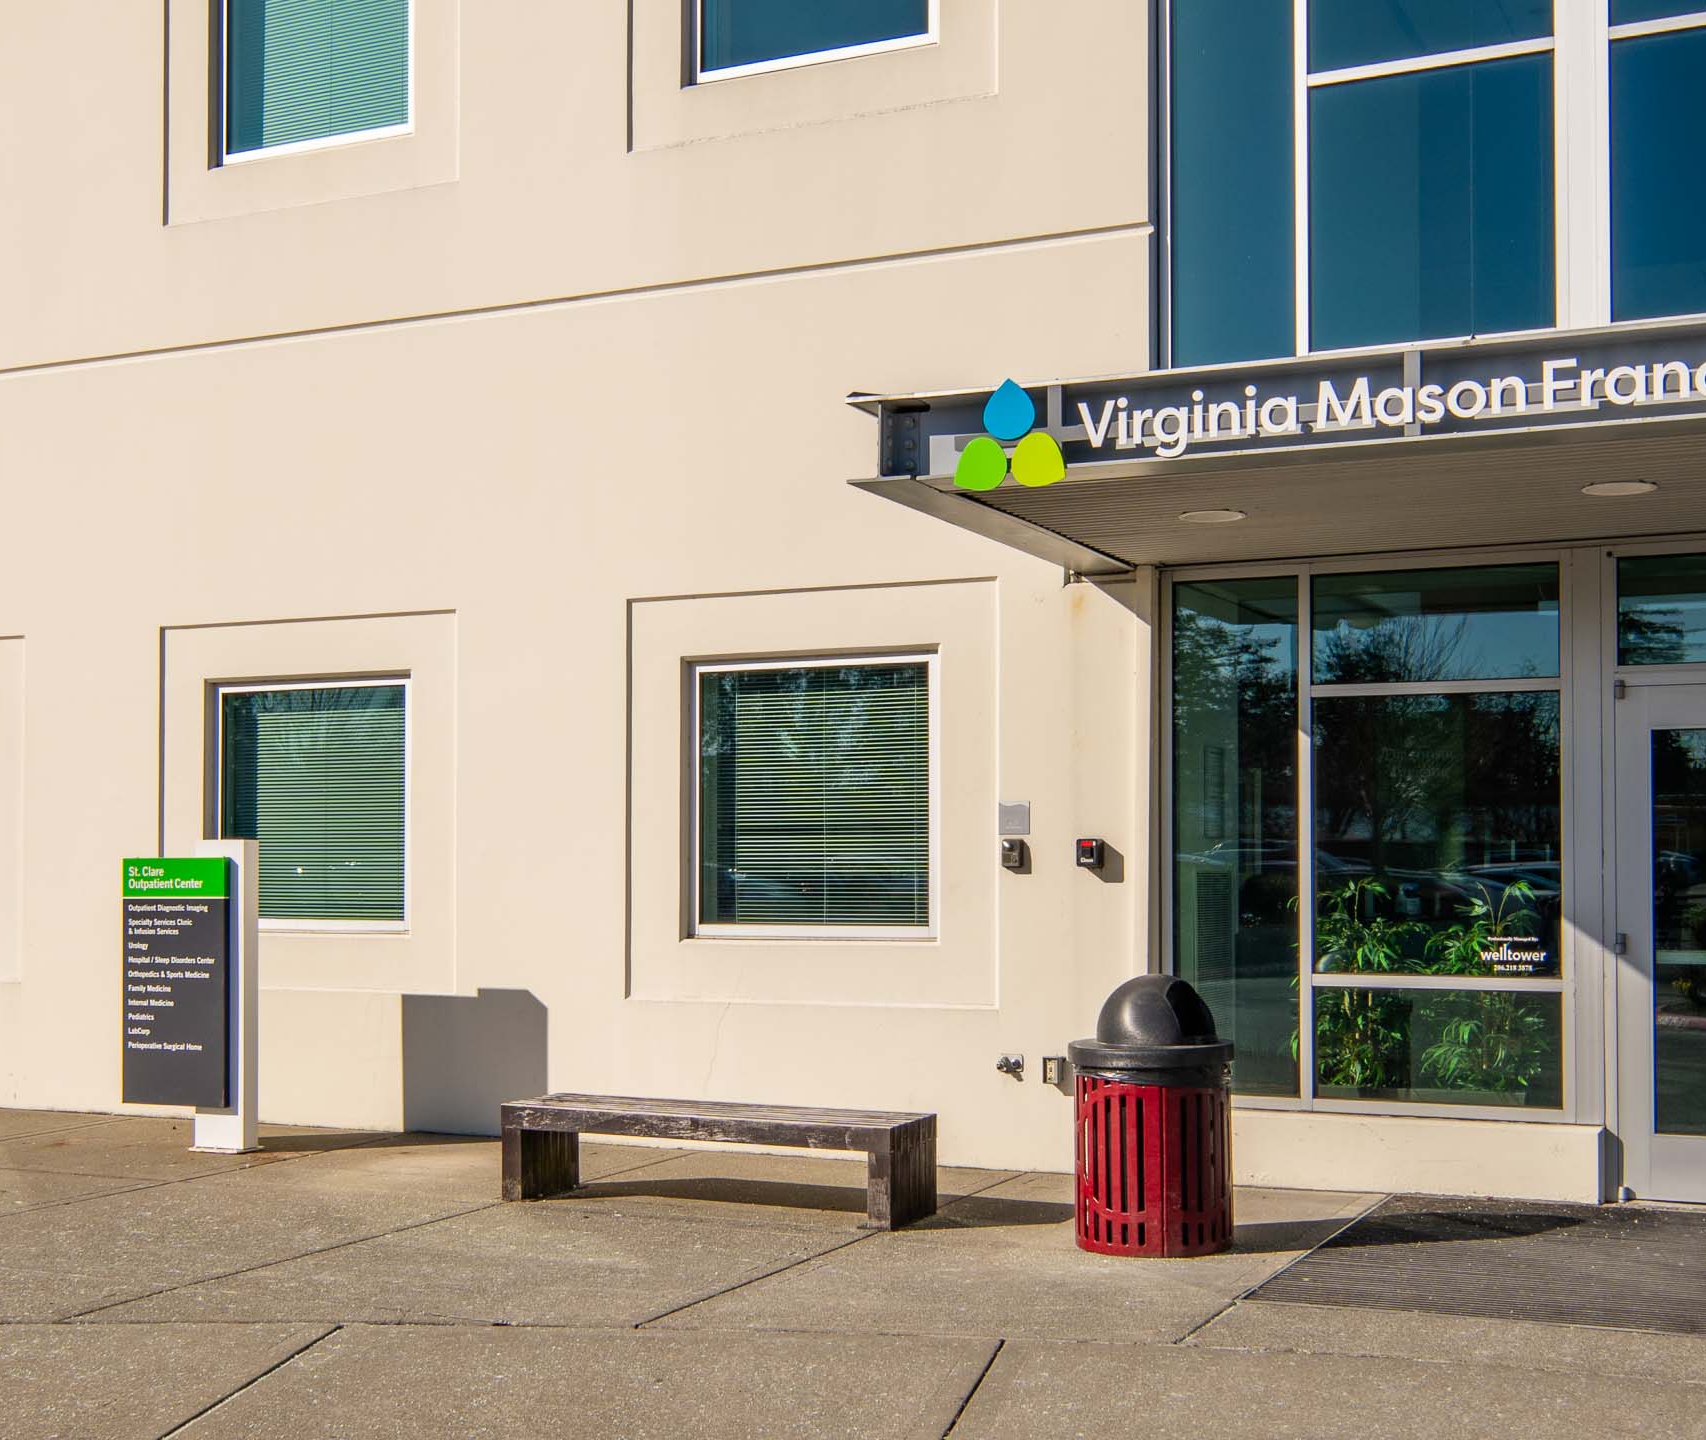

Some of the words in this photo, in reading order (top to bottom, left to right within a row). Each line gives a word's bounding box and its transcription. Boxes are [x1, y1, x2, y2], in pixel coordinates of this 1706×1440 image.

[1078, 385, 1296, 457] Virginia
[1316, 375, 1525, 429] Mason
[128, 866, 140, 877] St.
[142, 866, 165, 877] Clare
[128, 878, 173, 891] Outpatient
[174, 878, 204, 889] Center
[128, 904, 156, 912] Outpatient
[157, 904, 185, 912] Diagnostic
[186, 904, 209, 913] Imaging
[128, 918, 153, 927] Specialty
[154, 918, 176, 926] Services
[177, 918, 193, 926] Clinic
[128, 942, 149, 950] Urology
[1480, 943, 1547, 961] welltower
[128, 956, 150, 964] Hospital
[155, 956, 170, 964] Sleep
[171, 956, 196, 964] Disorders
[166, 971, 184, 979] Sports
[185, 971, 210, 979] Medicine
[128, 985, 146, 993] Family
[150, 999, 174, 1007] Medicine
[128, 1027, 150, 1036] LabCorp
[128, 1041, 162, 1050] Perioperative
[163, 1042, 185, 1051] Surgical
[186, 1043, 202, 1051] Home
